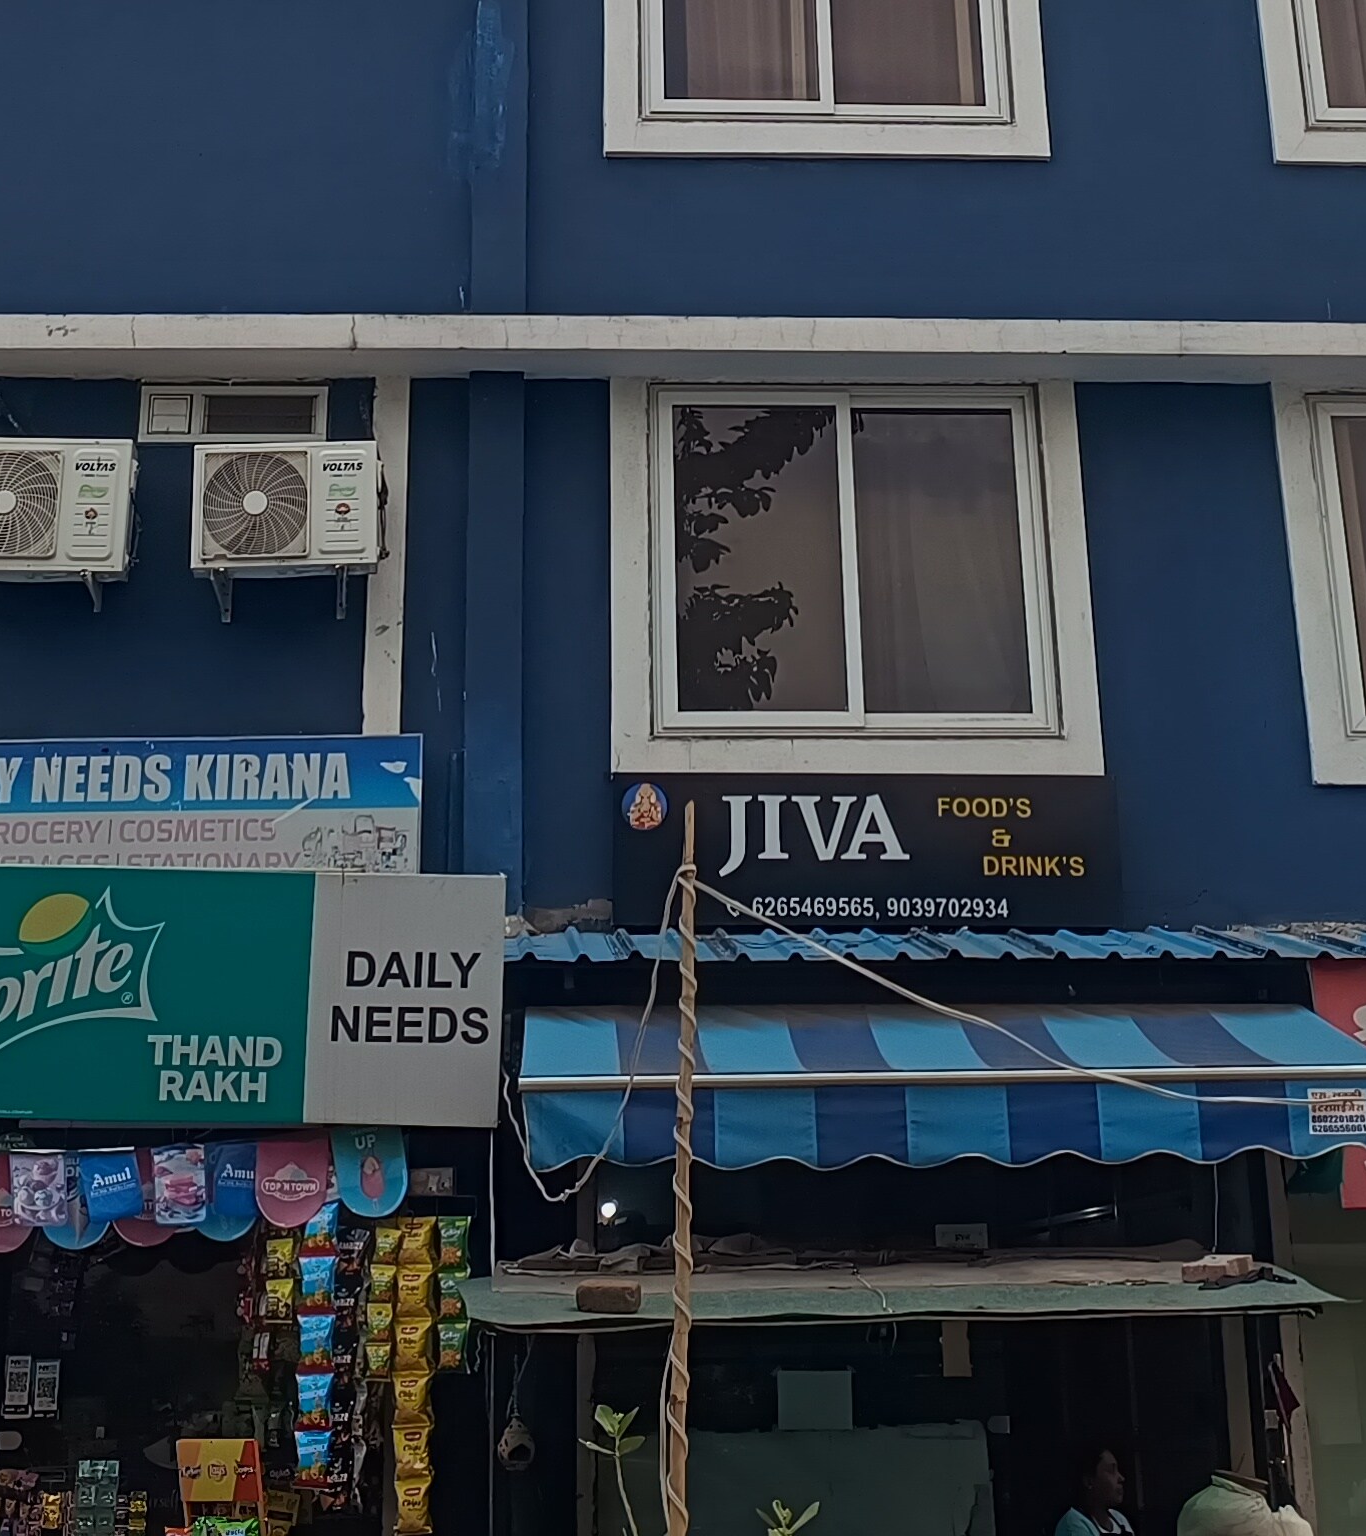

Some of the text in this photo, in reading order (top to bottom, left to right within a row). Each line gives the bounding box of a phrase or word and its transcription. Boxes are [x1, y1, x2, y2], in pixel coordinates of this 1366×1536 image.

[75, 462, 116, 471] VOLTAS
[322, 462, 363, 471] VOLTAS
[31, 753, 172, 803] NEEDS
[183, 752, 351, 801] KIRANA
[937, 797, 1032, 819] FOOD'S
[119, 817, 278, 844] COSMETICS
[718, 793, 911, 877] JIVA
[991, 828, 1012, 848] &
[982, 855, 1085, 877] DRINK'S
[751, 896, 1009, 921] 6265469565, 9039702934
[345, 950, 481, 989] DAILY
[329, 1006, 490, 1045] NEEDS
[147, 1033, 283, 1068] THAND
[158, 1070, 268, 1103] RAKH
[355, 1134, 376, 1149] UP
[91, 1166, 132, 1191] Amul
[221, 1163, 254, 1179] Amu
[264, 1182, 281, 1191] TOP
[291, 1182, 317, 1191] TOWN
